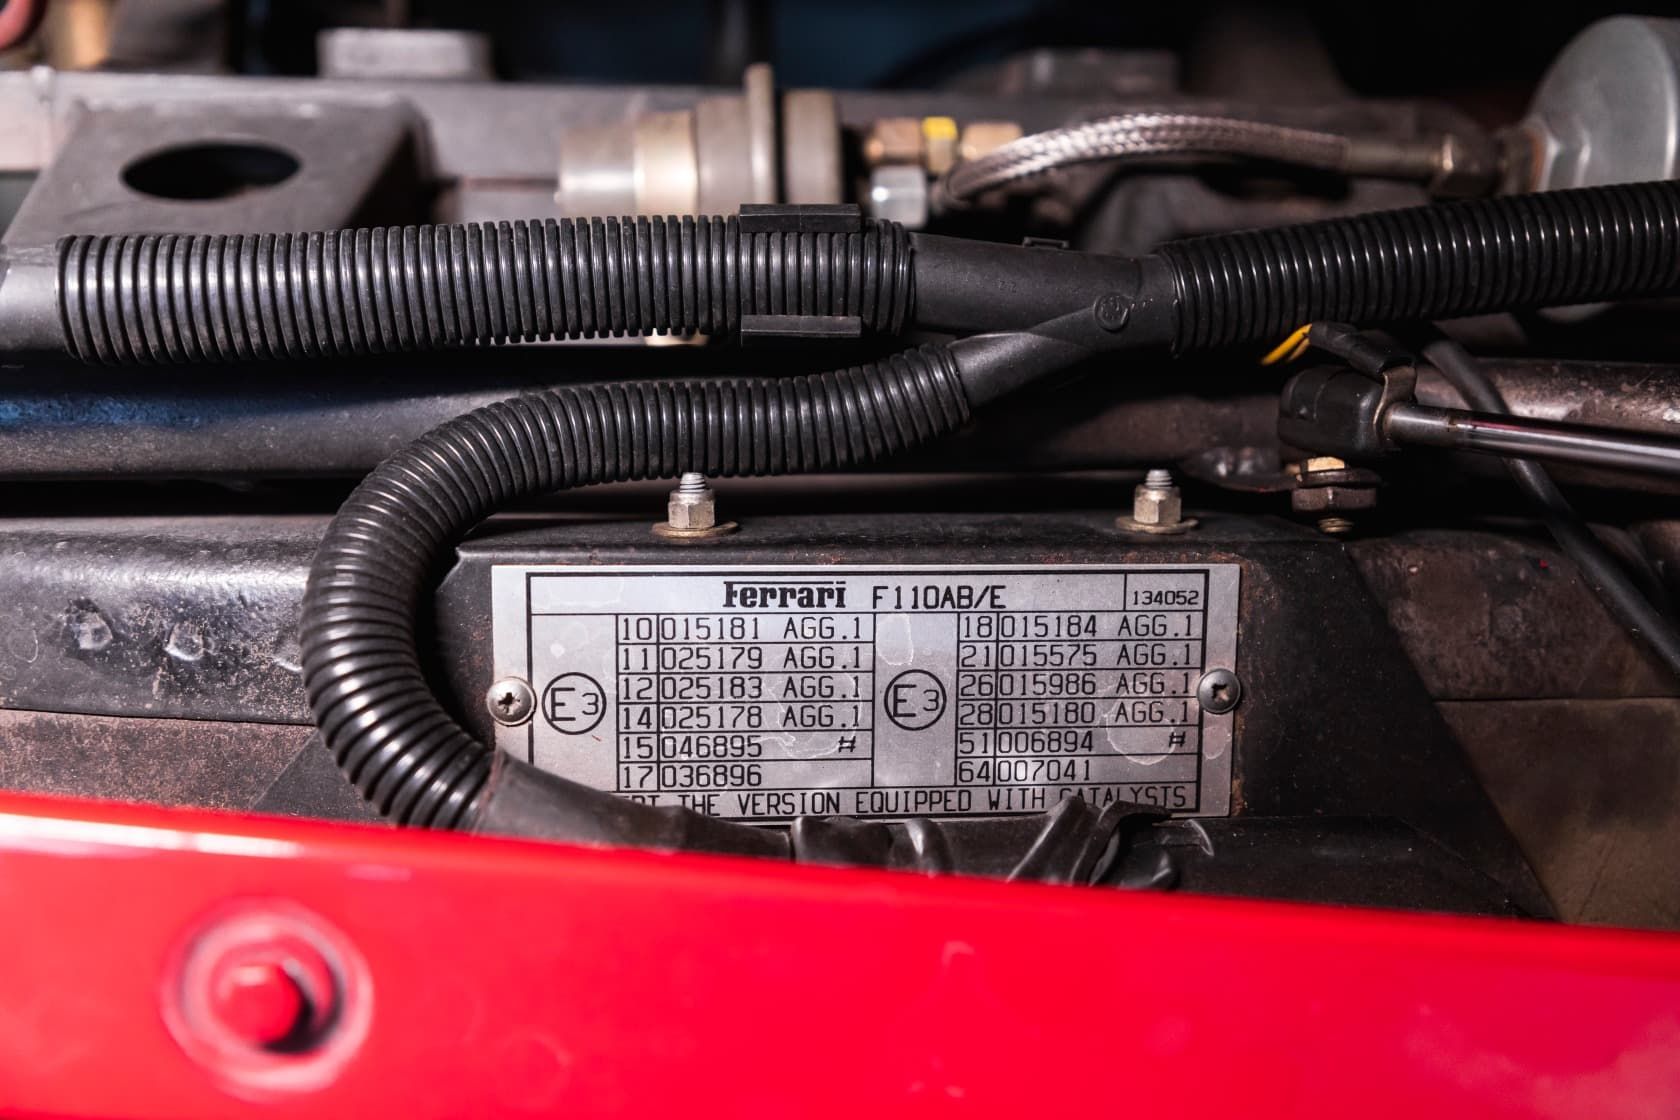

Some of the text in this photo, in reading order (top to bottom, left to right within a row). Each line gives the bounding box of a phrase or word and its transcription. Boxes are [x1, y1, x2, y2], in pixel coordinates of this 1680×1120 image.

[723, 581, 1006, 609] Ferrari F110AB/E
[1133, 590, 1199, 605] 134052
[623, 616, 861, 640] 10 015181 AGG.1
[964, 614, 1192, 638] 18 015184 AGG.1
[623, 646, 861, 670] 11 025179 AGG.1
[962, 644, 1191, 667] 21 015575 AGG.1
[623, 676, 860, 700] 12 025183 AGG.1
[961, 673, 1190, 696] 26 015986 AGG.1
[623, 705, 860, 730] 14 025178 AGG.1
[960, 702, 1189, 725] 28 015180 AGG.1
[623, 736, 653, 759] 15
[661, 736, 762, 758] 046895
[960, 732, 989, 754] 51
[998, 731, 1094, 753] 006894
[623, 765, 762, 789] 17 036896
[960, 760, 1091, 783] 64 007041
[678, 794, 721, 816] THE
[738, 792, 840, 815] VERSION
[856, 790, 971, 813] EQUIPPED
[988, 787, 1045, 811] WITH
